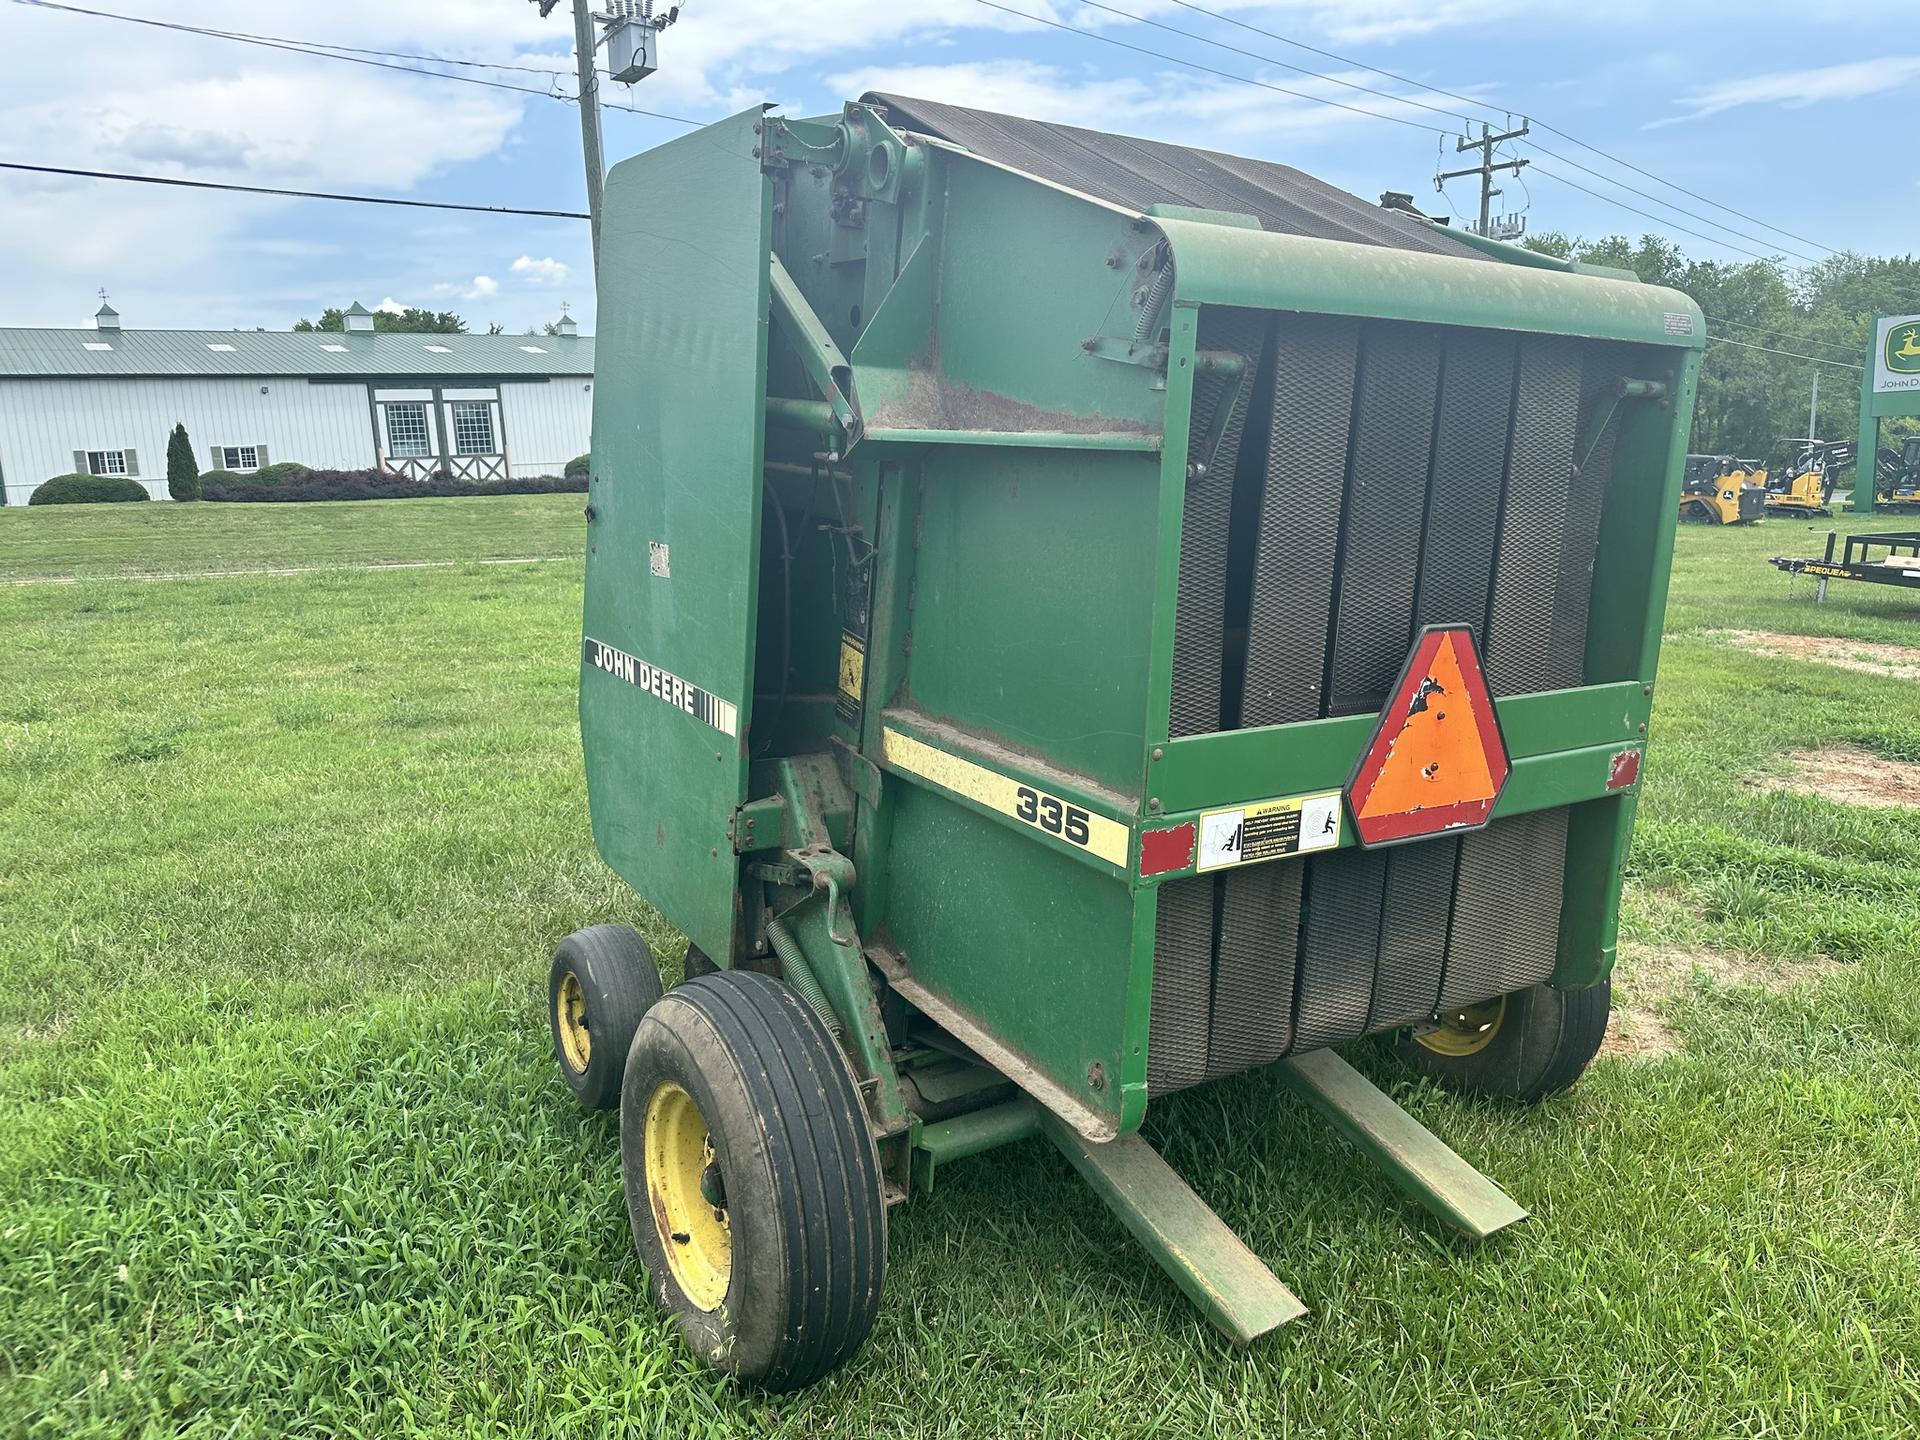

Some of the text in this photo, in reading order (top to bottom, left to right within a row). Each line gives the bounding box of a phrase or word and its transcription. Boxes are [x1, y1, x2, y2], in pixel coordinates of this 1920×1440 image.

[1880, 380, 1909, 389] JOHN
[594, 643, 695, 715] JOHN DEERE
[1016, 786, 1090, 846] 335
[1262, 804, 1291, 815] WARNING
